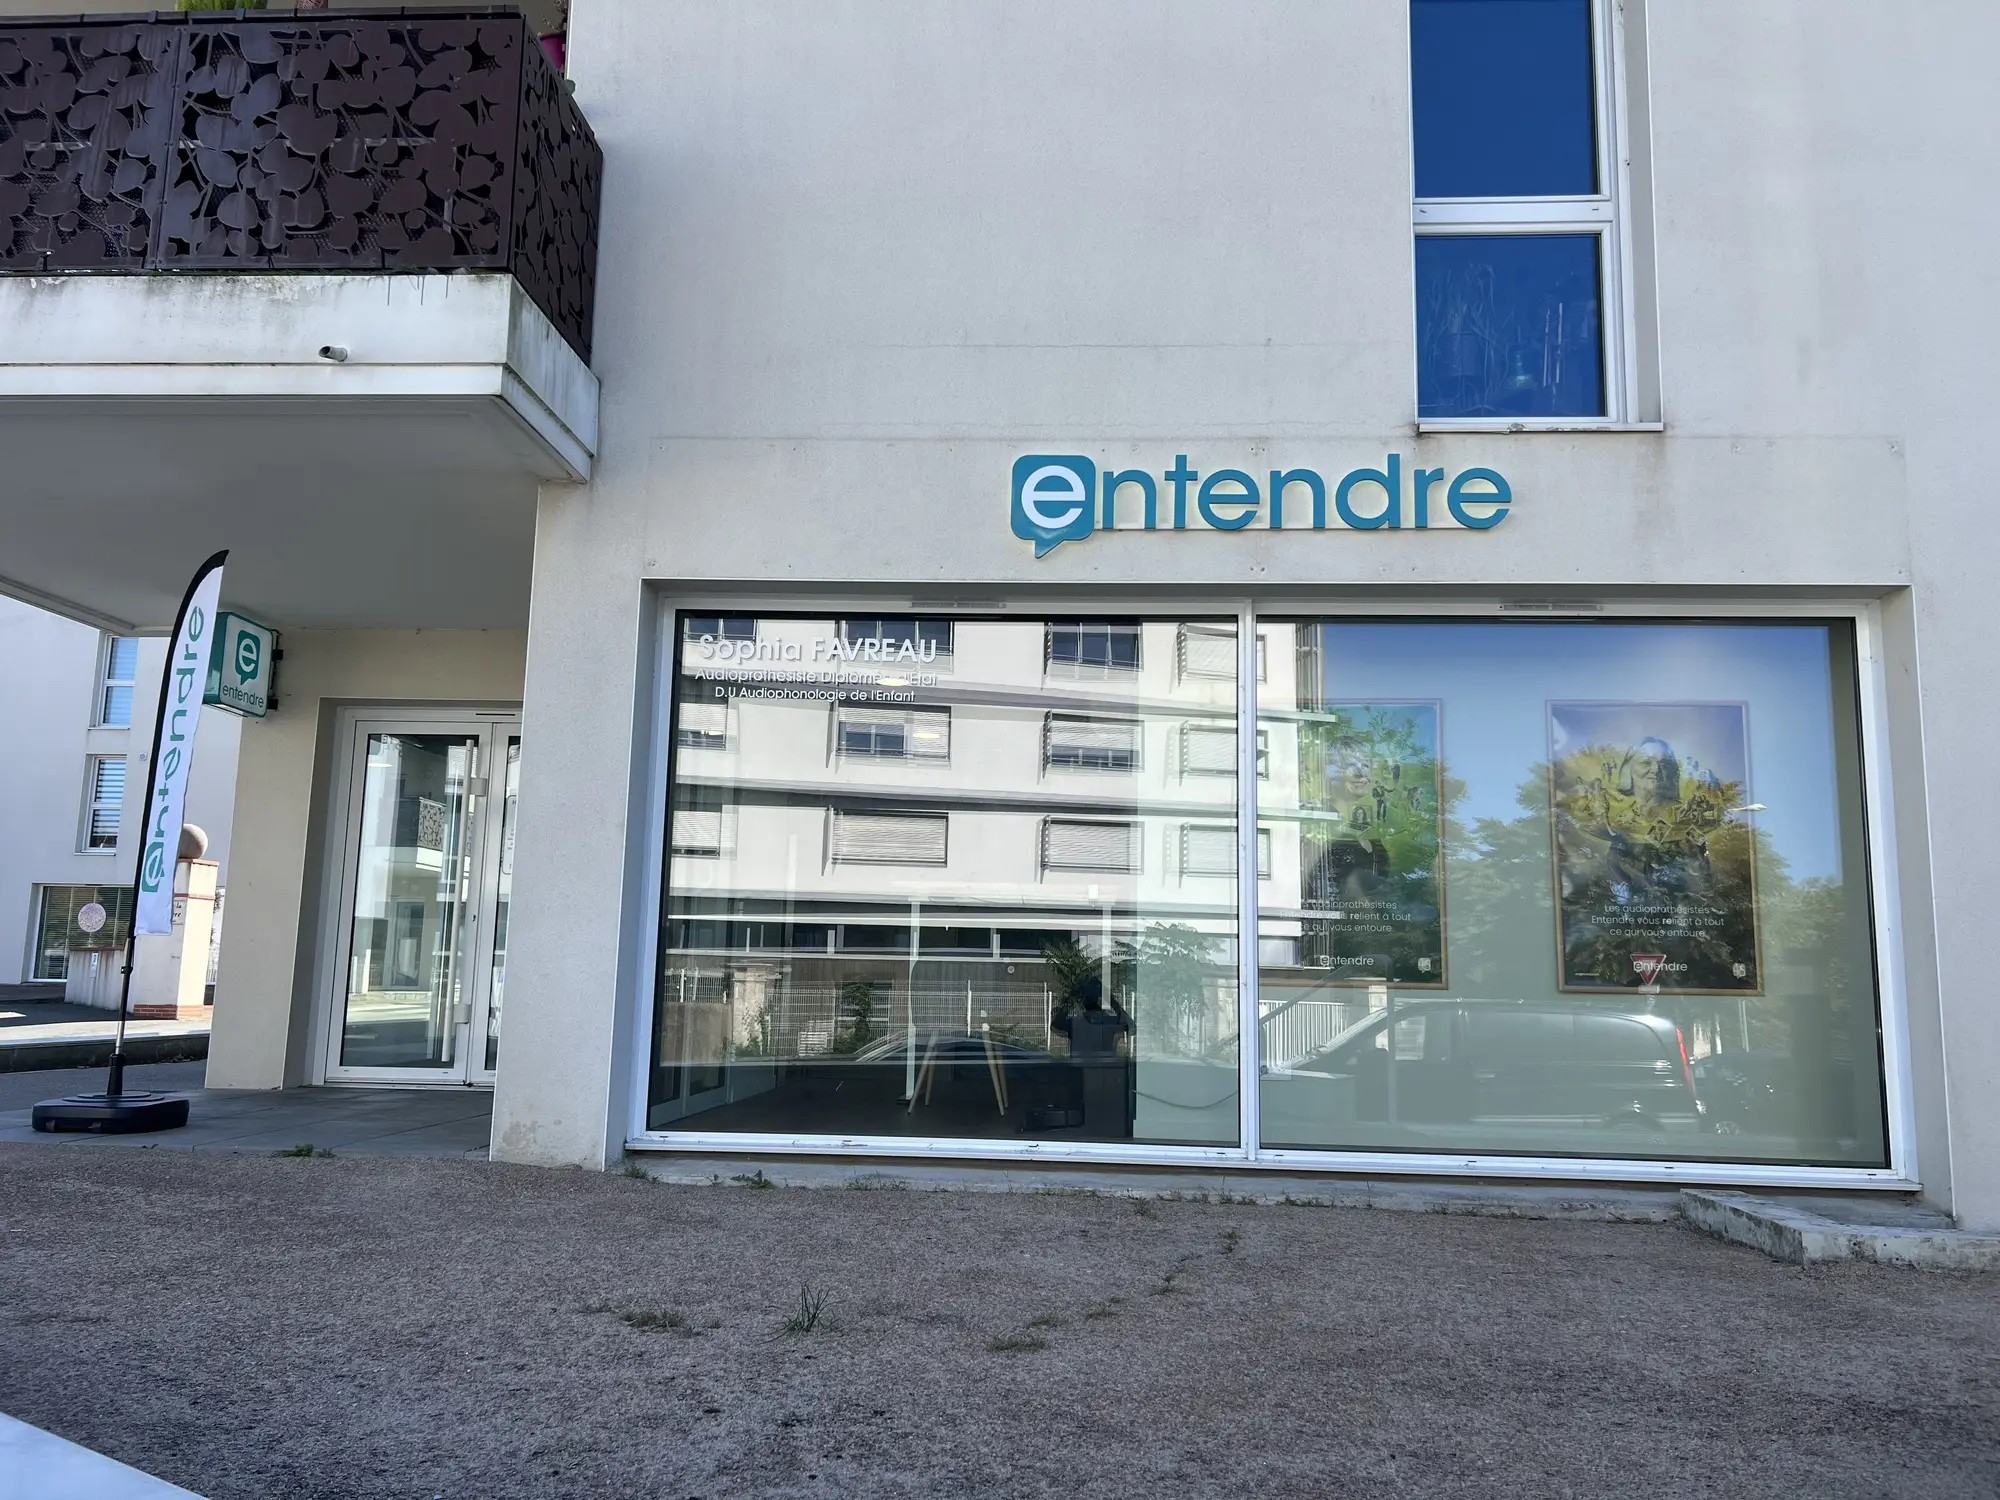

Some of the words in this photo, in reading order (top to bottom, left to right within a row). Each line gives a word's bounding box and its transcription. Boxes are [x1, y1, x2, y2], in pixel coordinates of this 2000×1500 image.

[1012, 454, 1512, 531] entendre
[699, 635, 803, 665] Sophia
[811, 637, 938, 663] FAVREAU
[694, 668, 817, 685] Audioprothésiste
[222, 684, 265, 708] entendre
[715, 686, 737, 698] D.U
[738, 687, 847, 702] Audiophonologie
[850, 689, 868, 700] de
[871, 689, 916, 702] l'Enfant
[142, 605, 205, 891] entendre
[1604, 904, 1621, 913] Les
[1622, 903, 1710, 915] audioprothésistes
[1350, 912, 1380, 921] relient
[1391, 912, 1412, 922] tout
[1591, 914, 1635, 924] Entendre
[1637, 916, 1661, 925] vous
[1662, 916, 1693, 926] relient
[1704, 917, 1725, 926] tout
[1330, 924, 1352, 932] vous
[1609, 928, 1622, 936] ce
[1624, 928, 1640, 938] qui
[1641, 928, 1665, 937] vous
[1319, 954, 1375, 967] entendre
[1633, 961, 1688, 972] entendre
